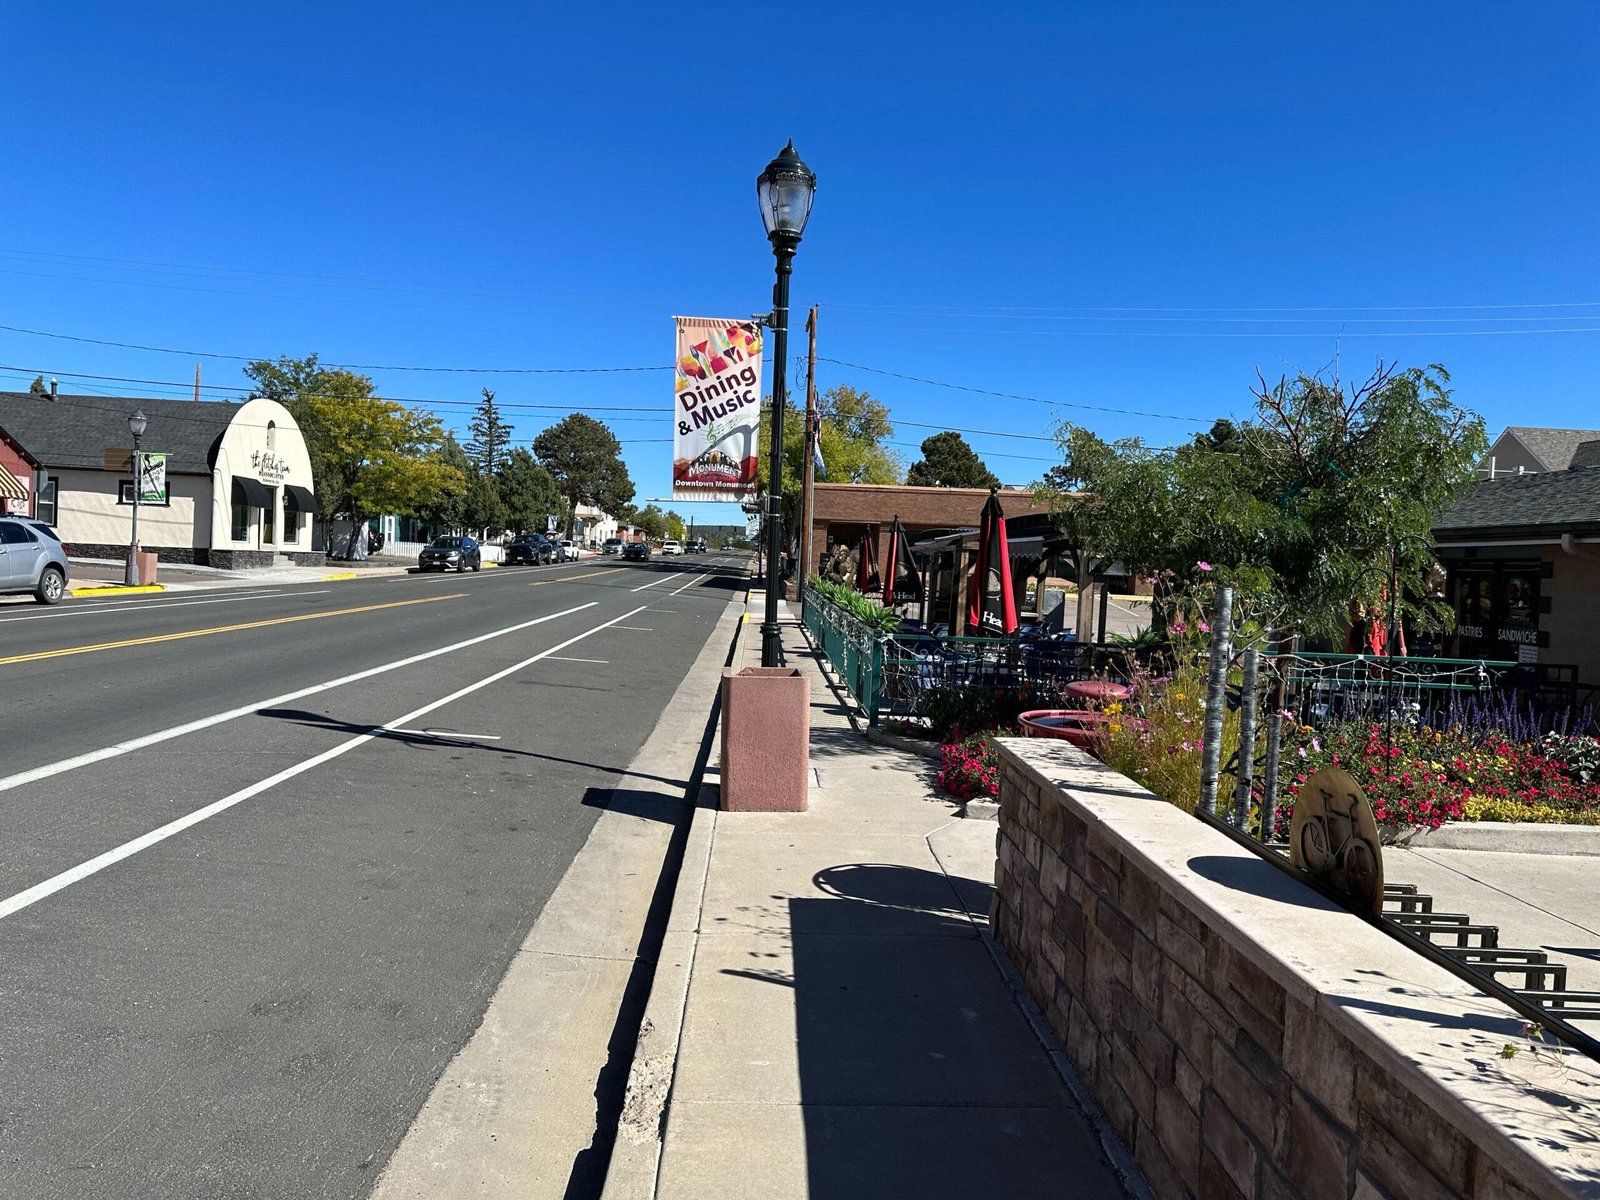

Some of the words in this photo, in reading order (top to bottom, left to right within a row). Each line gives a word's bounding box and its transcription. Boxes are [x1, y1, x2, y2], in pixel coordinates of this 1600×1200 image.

[679, 366, 757, 412] Dining
[678, 421, 694, 436] &
[690, 389, 756, 430] Music
[716, 480, 756, 489] Monument
[983, 611, 1003, 628] Hea
[1457, 624, 1483, 639] PASTRIES
